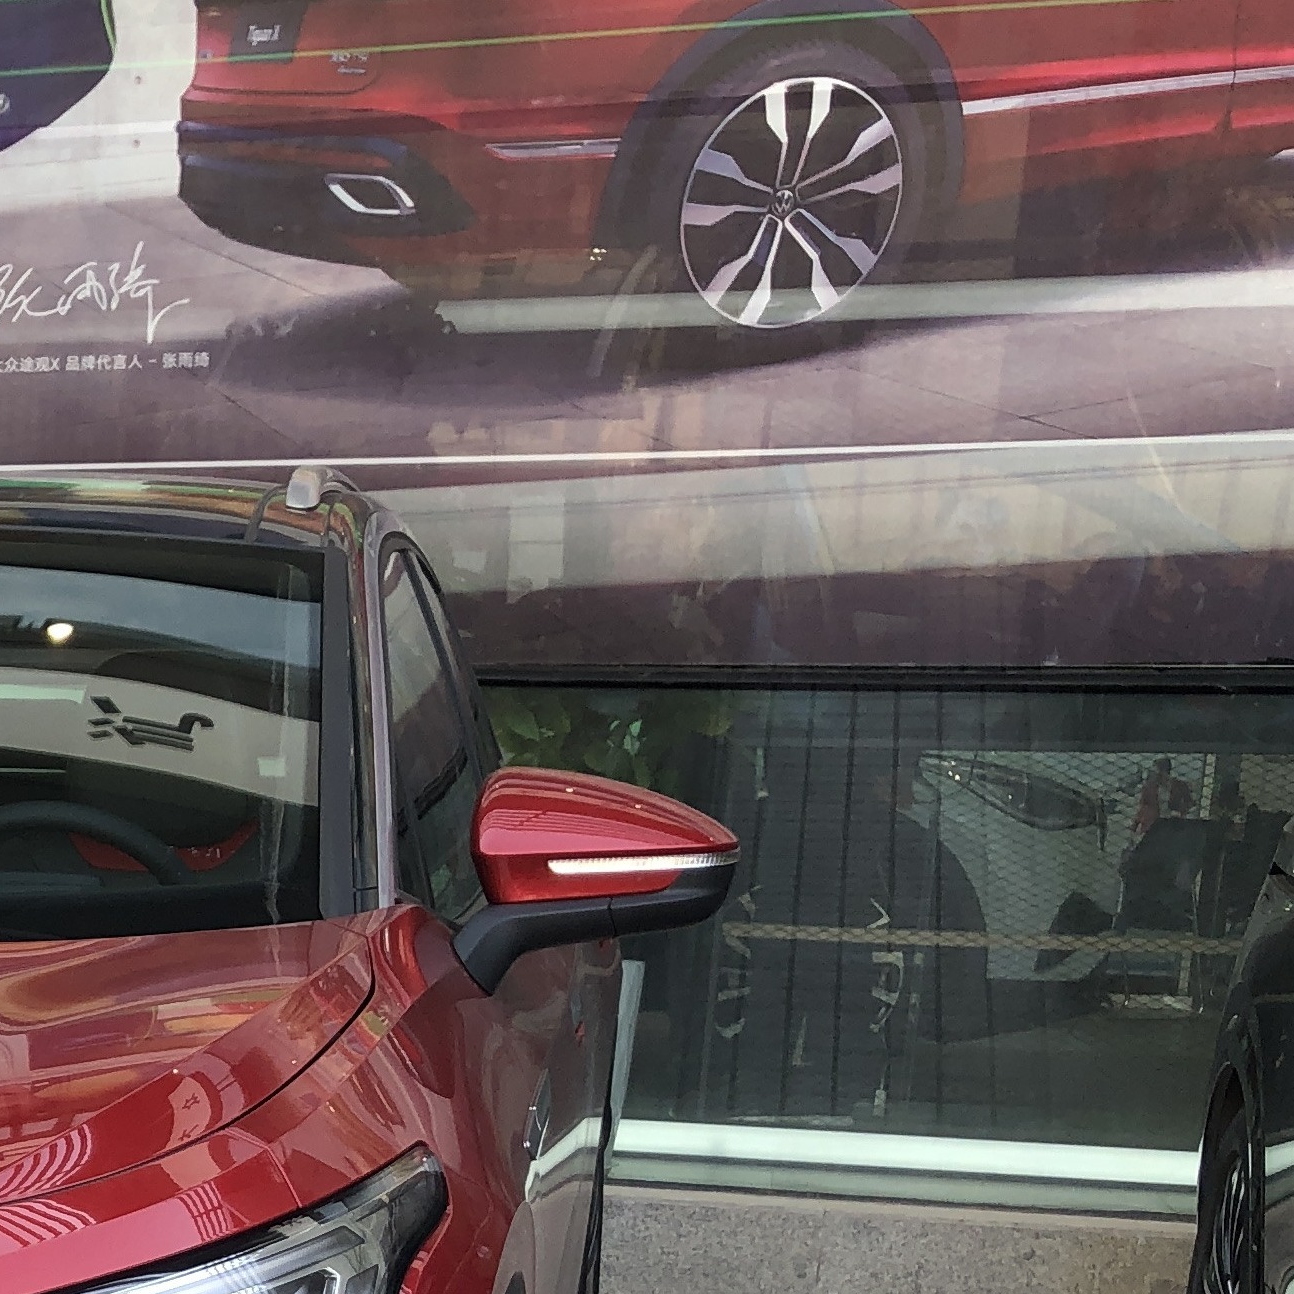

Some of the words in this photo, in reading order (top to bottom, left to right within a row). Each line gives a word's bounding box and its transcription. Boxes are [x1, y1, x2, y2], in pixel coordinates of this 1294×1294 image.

[65, 354, 143, 371] 品牌代言人
